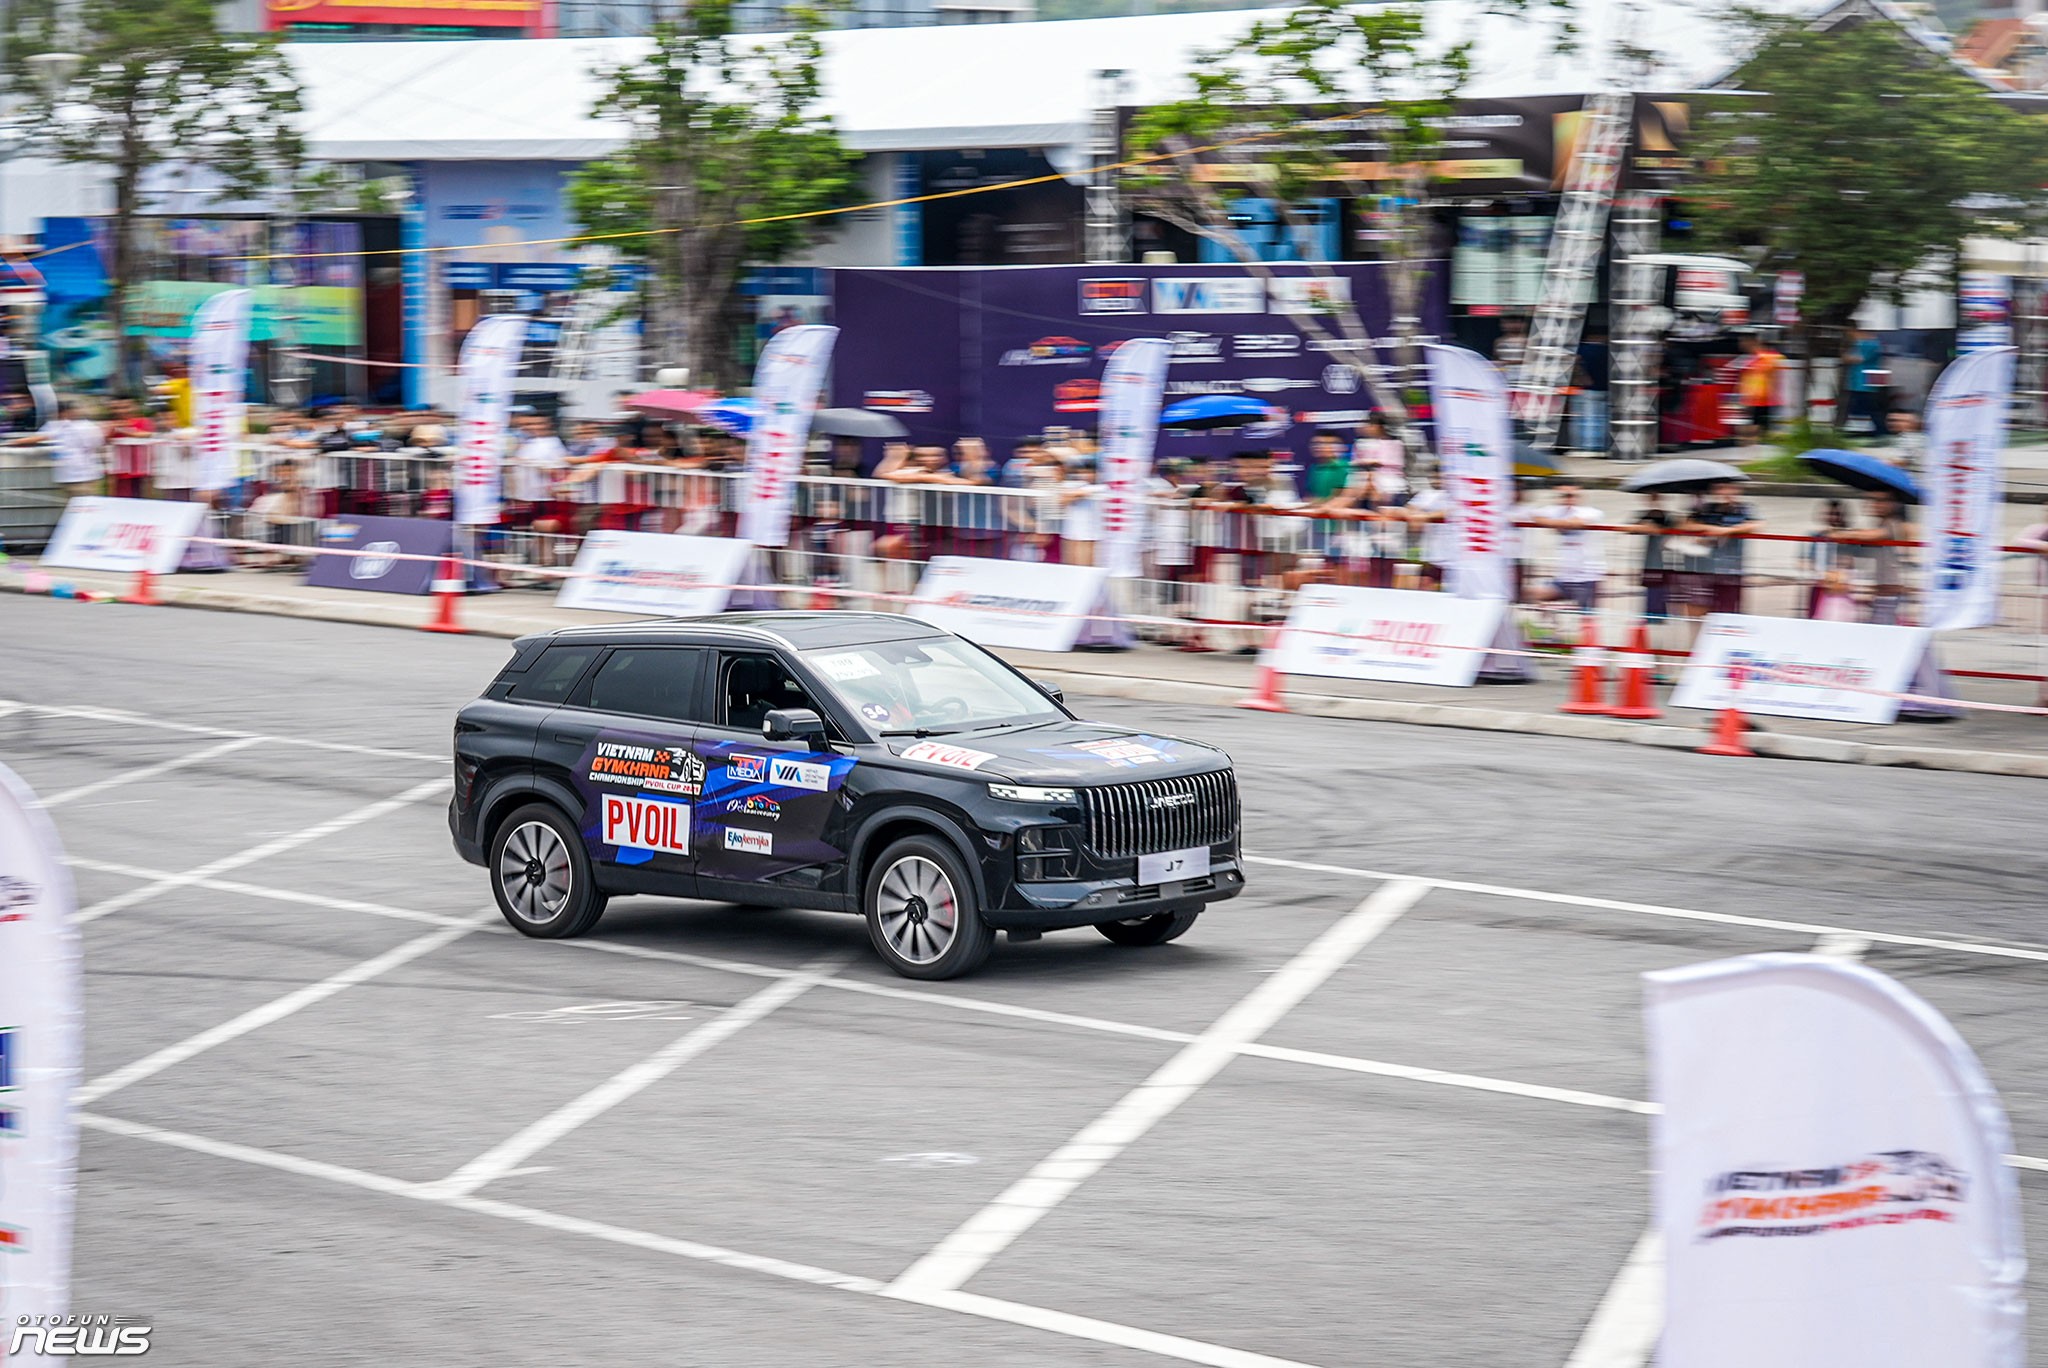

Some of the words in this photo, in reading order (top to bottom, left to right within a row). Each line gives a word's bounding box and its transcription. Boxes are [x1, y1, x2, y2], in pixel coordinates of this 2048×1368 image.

[862, 705, 888, 719] 34
[597, 742, 655, 761] VIETNAM
[908, 743, 980, 767] PVOIL
[591, 757, 670, 779] GYMKHANA
[730, 766, 763, 782] MEDIA
[589, 772, 644, 786] CHAMPIONSHIP
[645, 779, 665, 789] PVOIL
[607, 799, 683, 850] PVOIL
